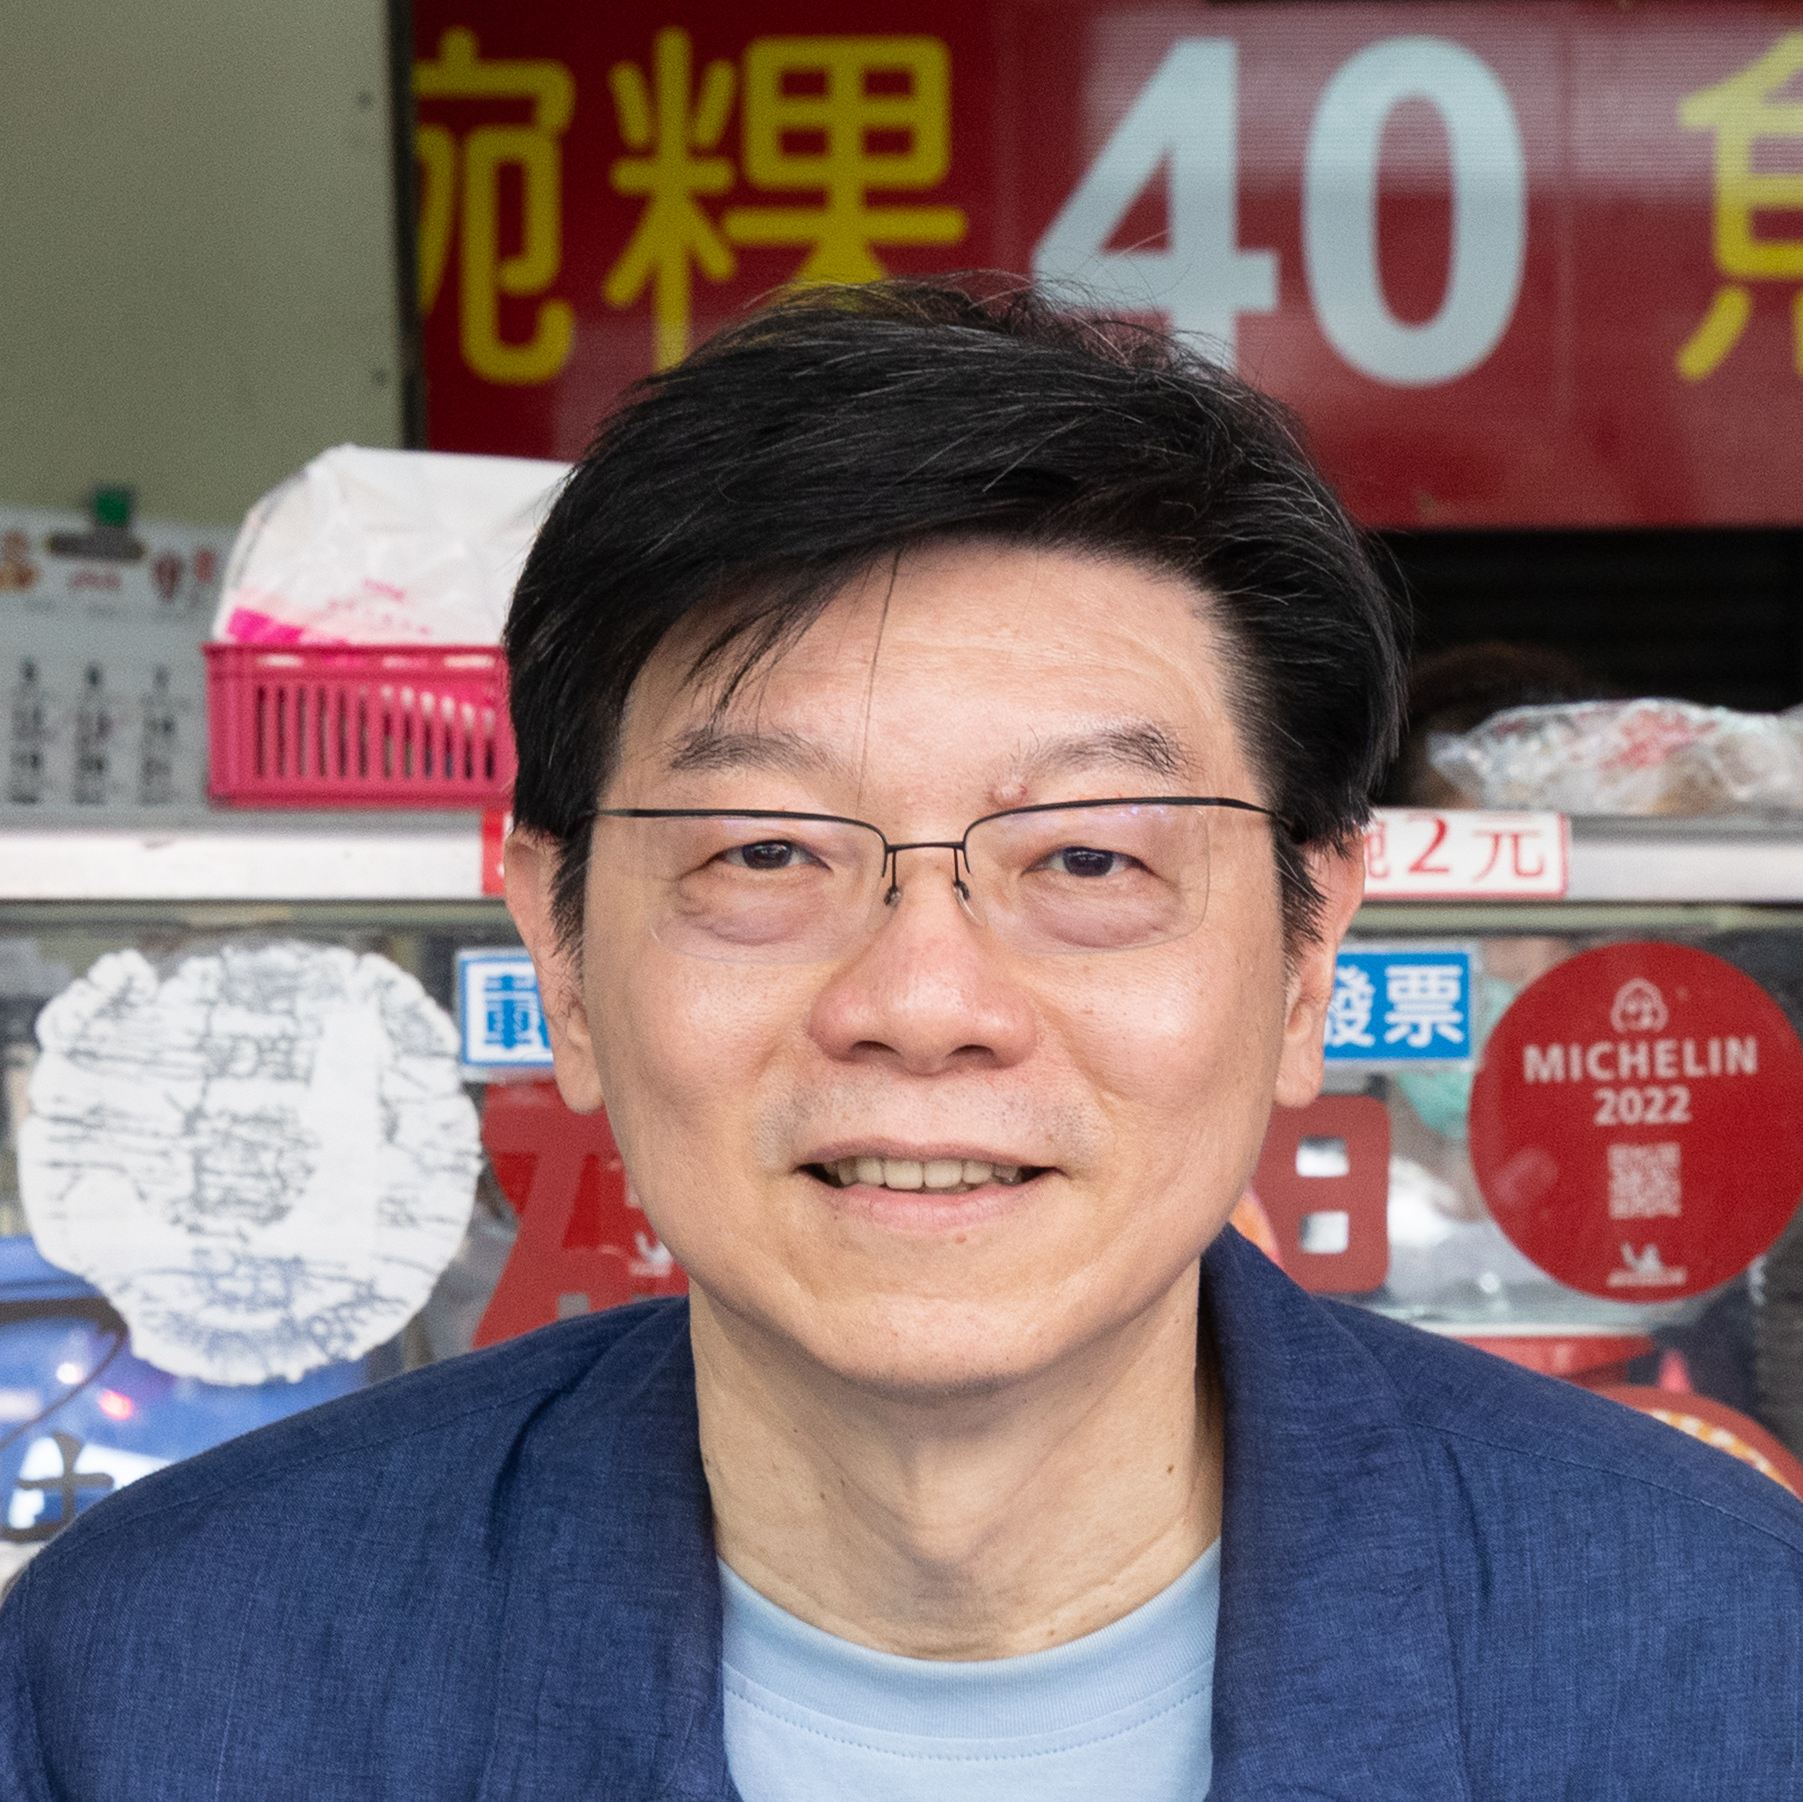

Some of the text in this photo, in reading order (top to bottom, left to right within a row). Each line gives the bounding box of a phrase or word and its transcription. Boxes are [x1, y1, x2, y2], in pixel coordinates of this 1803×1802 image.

[1030, 35, 1528, 388] 40
[1523, 1036, 1759, 1083] MICHELIN
[1594, 1087, 1691, 1126] 2022
